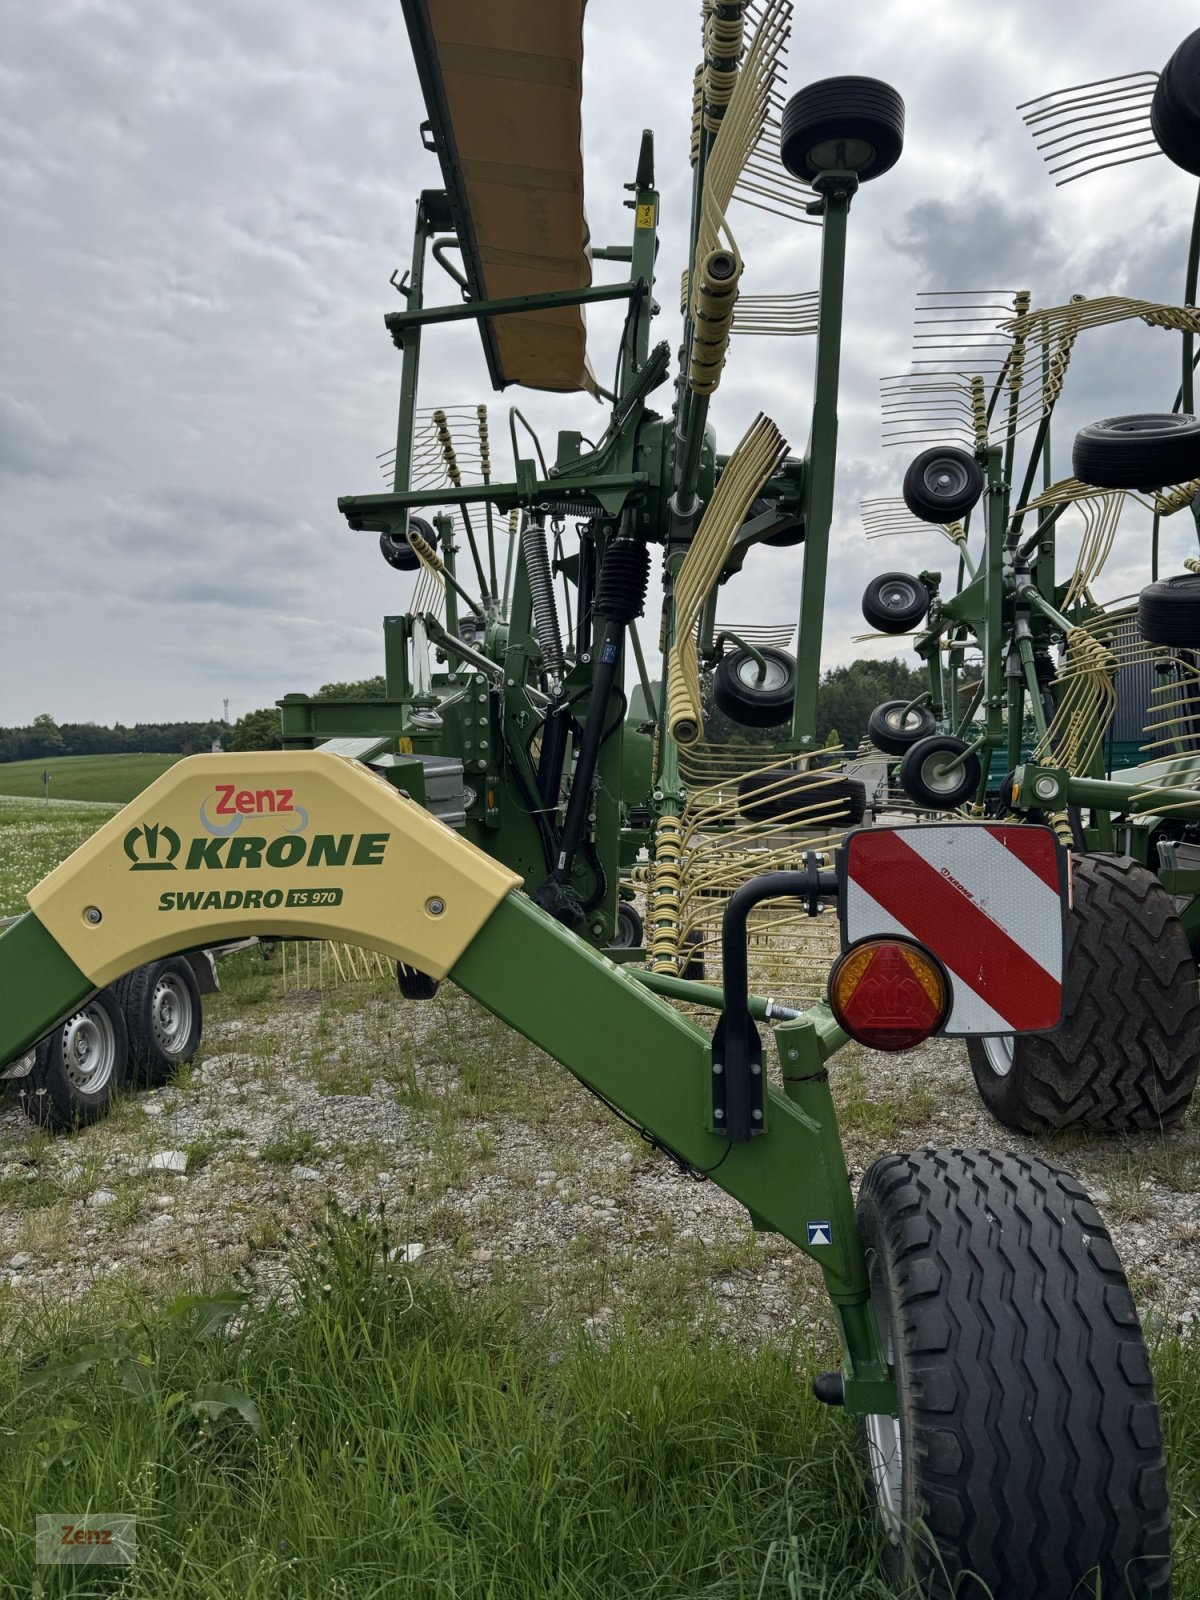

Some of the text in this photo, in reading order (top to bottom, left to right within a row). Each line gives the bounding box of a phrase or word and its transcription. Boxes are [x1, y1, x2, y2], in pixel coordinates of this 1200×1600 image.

[215, 785, 294, 815] Zenz
[185, 833, 390, 870] KRONE
[158, 889, 337, 911] SWADRO TS 970
[947, 875, 974, 899] KRONE
